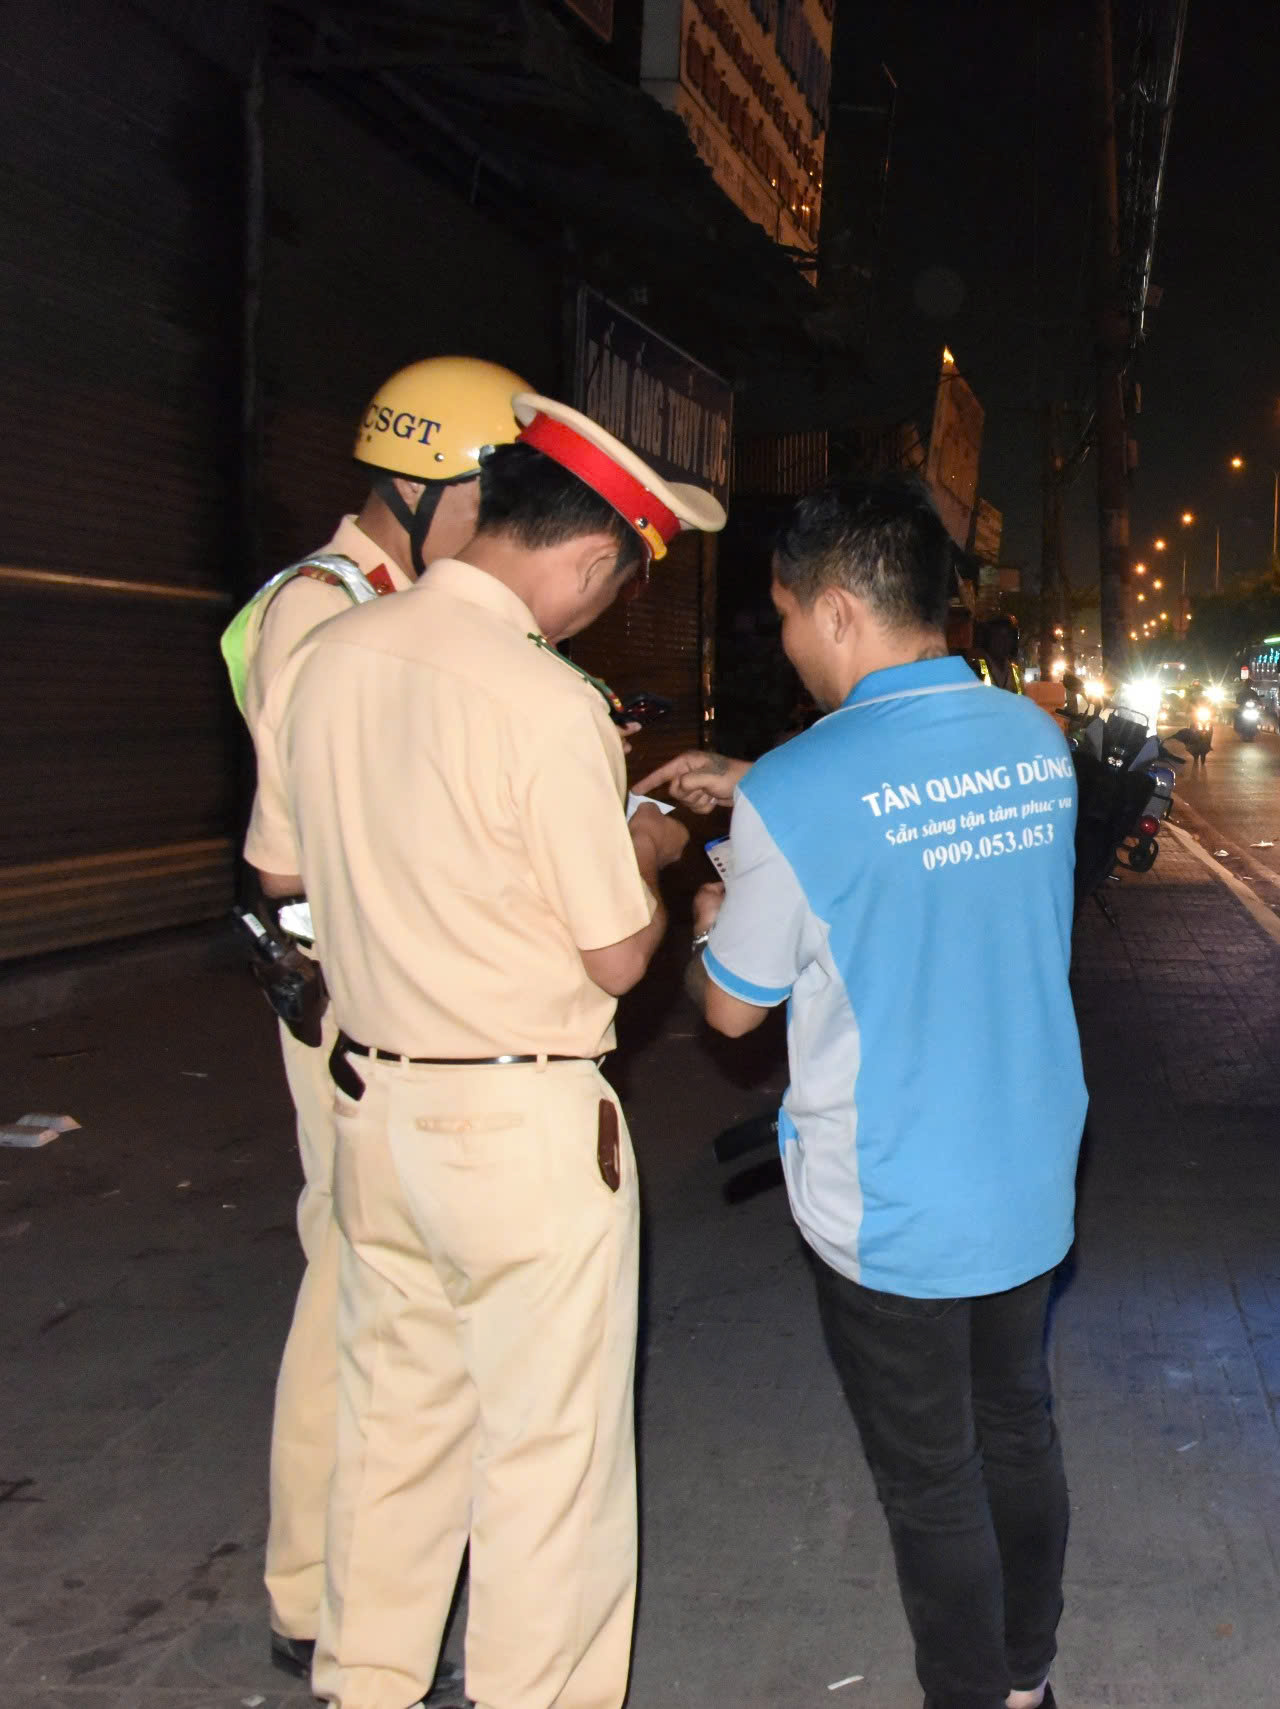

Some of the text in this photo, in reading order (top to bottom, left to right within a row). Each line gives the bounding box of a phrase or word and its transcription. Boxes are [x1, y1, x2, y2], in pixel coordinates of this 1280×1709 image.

[364, 403, 441, 446] CSGT
[861, 755, 1073, 817] TÂN QUANG DŨNG
[885, 823, 918, 846] Sẵn
[922, 818, 956, 837] sàng
[960, 811, 985, 831] tận
[988, 805, 1018, 824] tâm
[922, 823, 1055, 871] 0909.053.053
